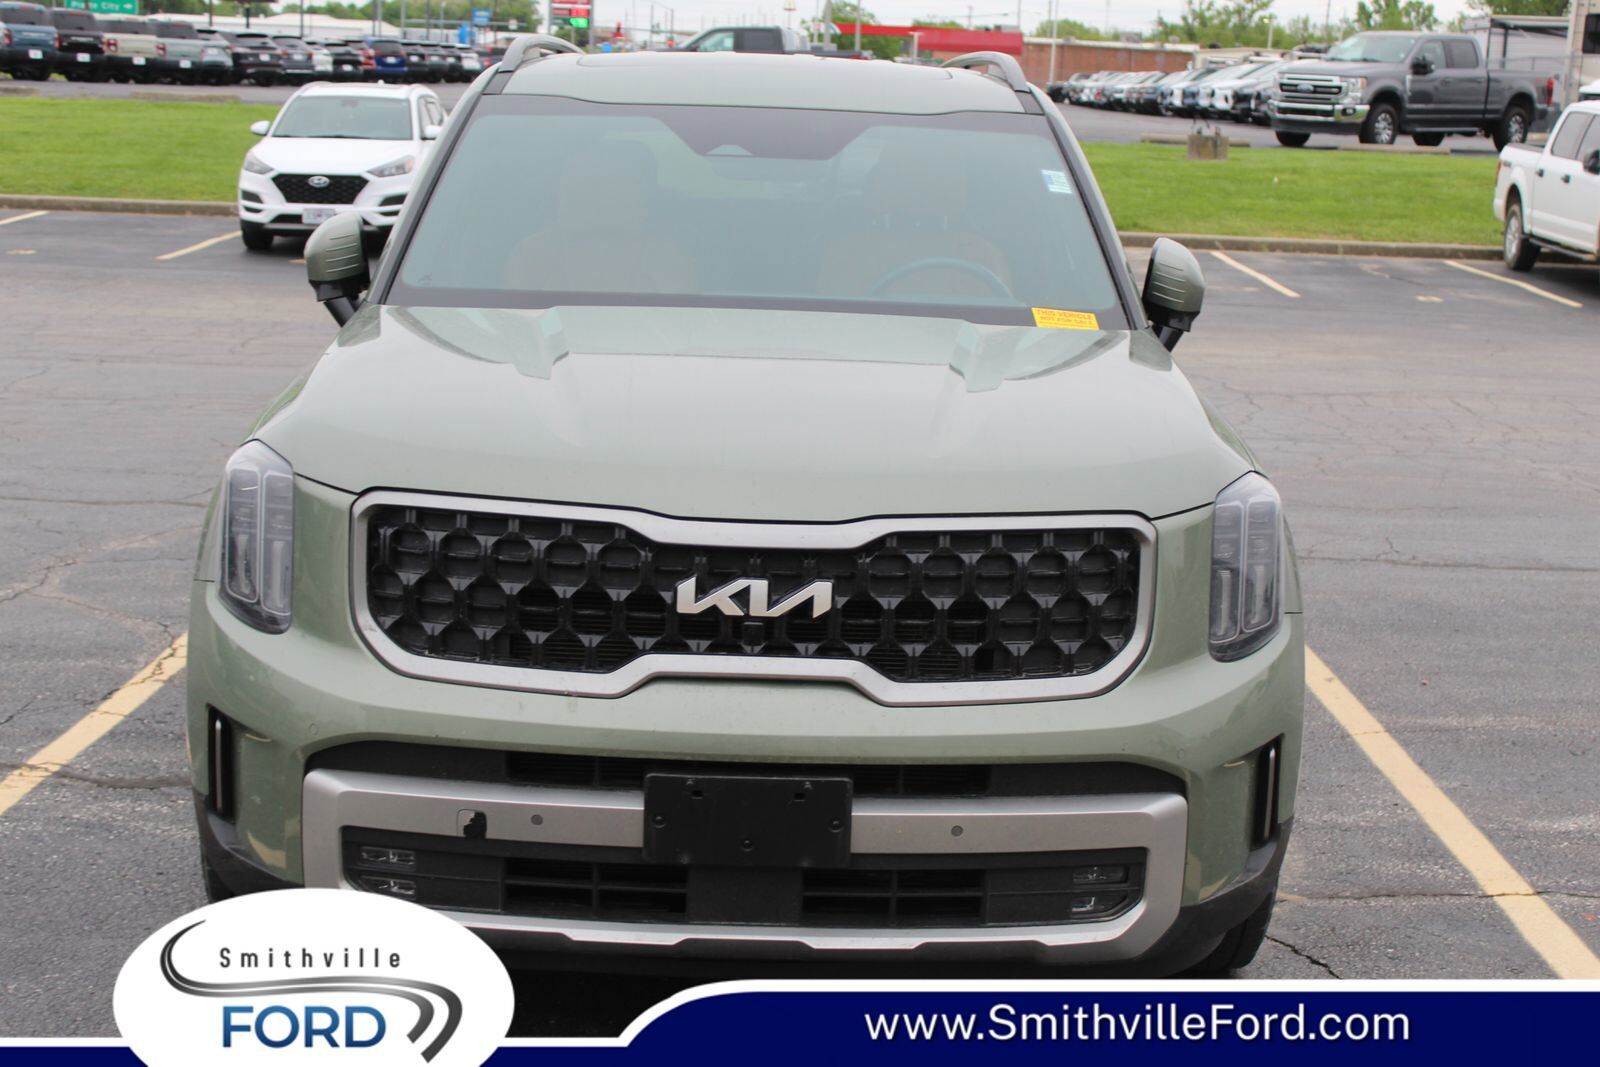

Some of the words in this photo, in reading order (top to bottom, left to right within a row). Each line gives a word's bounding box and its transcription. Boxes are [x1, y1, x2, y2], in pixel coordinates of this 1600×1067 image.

[71, 1, 98, 9] Plate
[100, 2, 120, 11] City
[1056, 311, 1094, 321] VEHICLE
[676, 576, 833, 618] KIA
